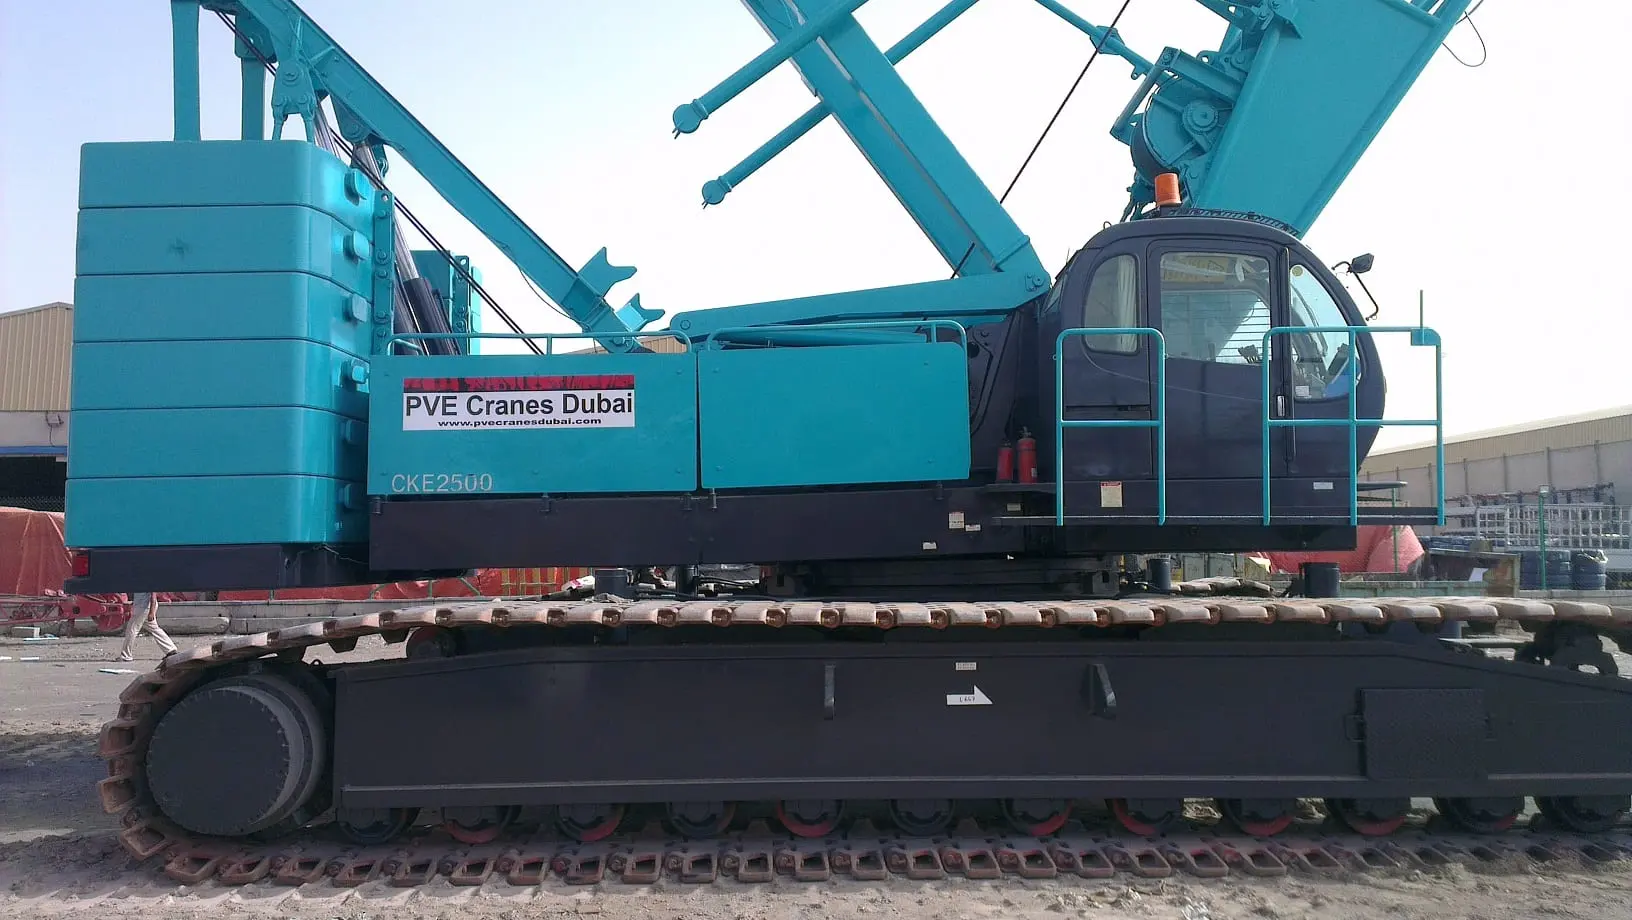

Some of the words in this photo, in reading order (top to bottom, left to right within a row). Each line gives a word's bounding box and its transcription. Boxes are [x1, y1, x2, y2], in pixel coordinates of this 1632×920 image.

[405, 395, 458, 416] PVE
[466, 395, 554, 416] Cranes
[562, 392, 632, 413] Dubai
[437, 418, 602, 427] www.pvecranesdubai.com
[391, 474, 493, 492] CKE2500
